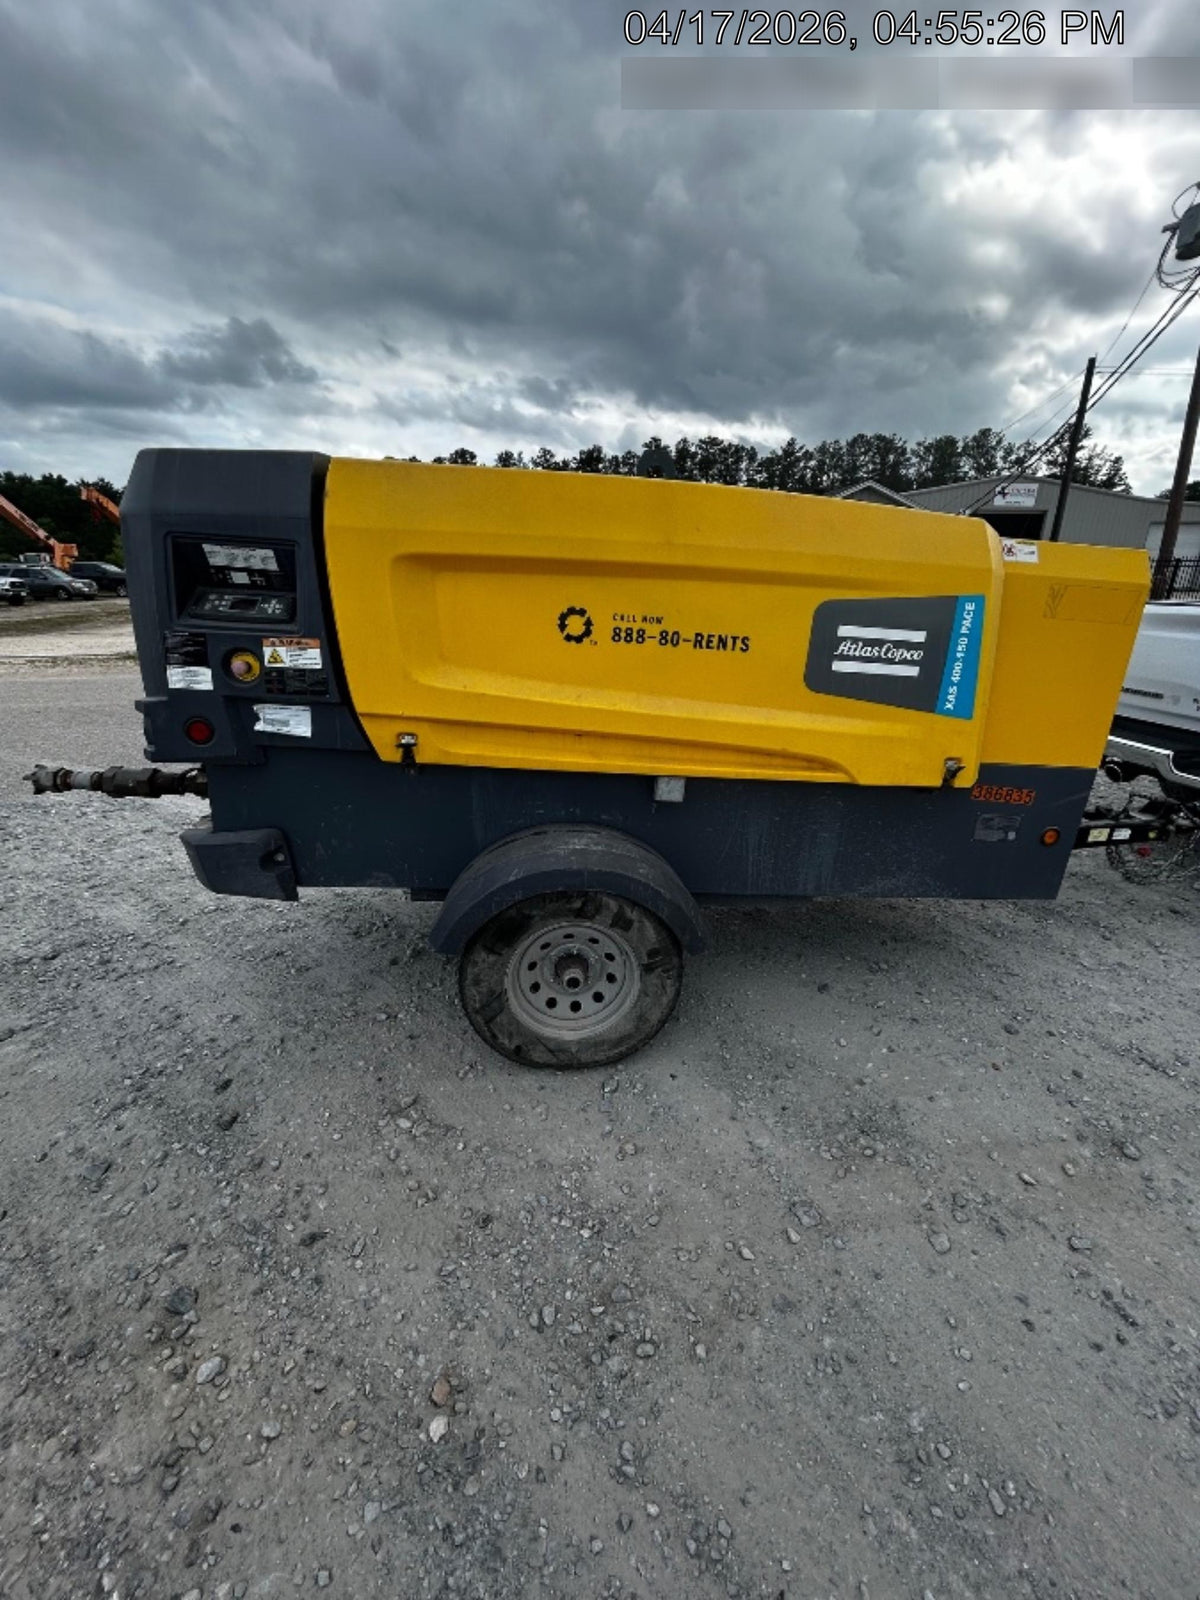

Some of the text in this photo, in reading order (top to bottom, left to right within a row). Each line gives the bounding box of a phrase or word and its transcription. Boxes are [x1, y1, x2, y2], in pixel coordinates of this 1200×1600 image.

[613, 613, 664, 625] CALL NOW
[611, 626, 751, 653] 888-80-RENTS
[833, 640, 924, 662] Atlas Copco
[944, 686, 958, 710] XAS
[960, 601, 976, 634] PACE
